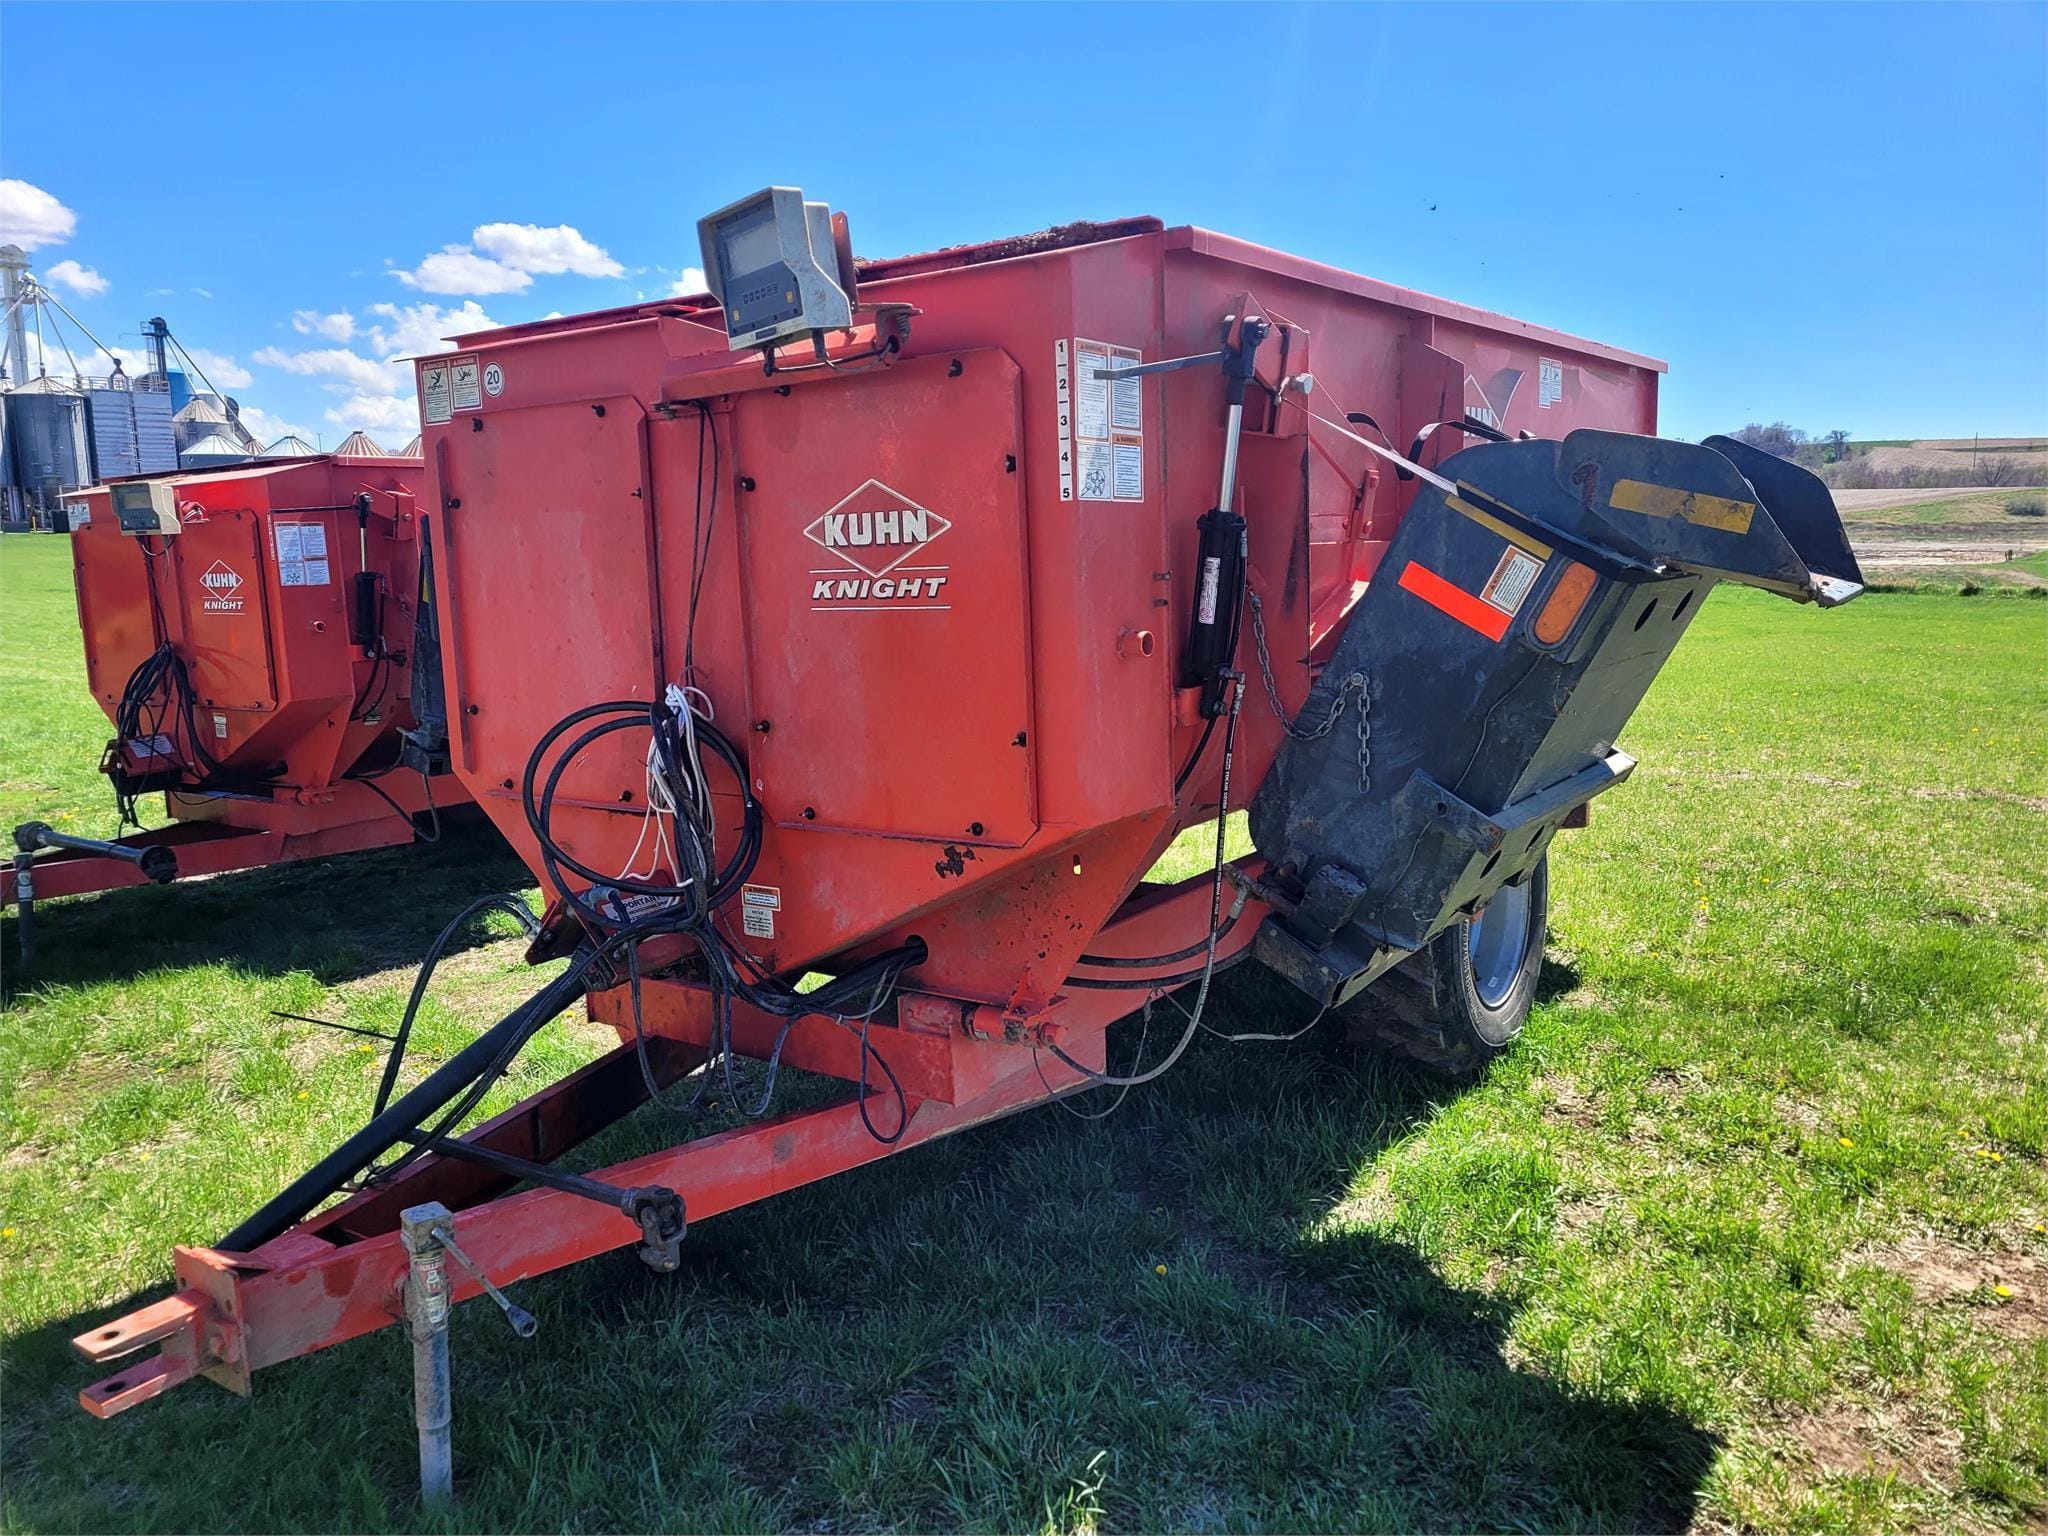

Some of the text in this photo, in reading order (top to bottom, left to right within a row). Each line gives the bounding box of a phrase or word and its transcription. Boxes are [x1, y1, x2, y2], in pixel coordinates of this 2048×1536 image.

[1058, 341, 1064, 352] 1
[486, 370, 500, 385] 20
[1059, 379, 1067, 389] 2
[1060, 415, 1068, 426] 3
[1061, 451, 1069, 462] 4
[1062, 488, 1070, 498] 5
[824, 508, 928, 548] KUHN
[205, 573, 237, 588] KUHN
[812, 576, 947, 600] KNIGHT
[204, 601, 243, 610] KNIGHT
